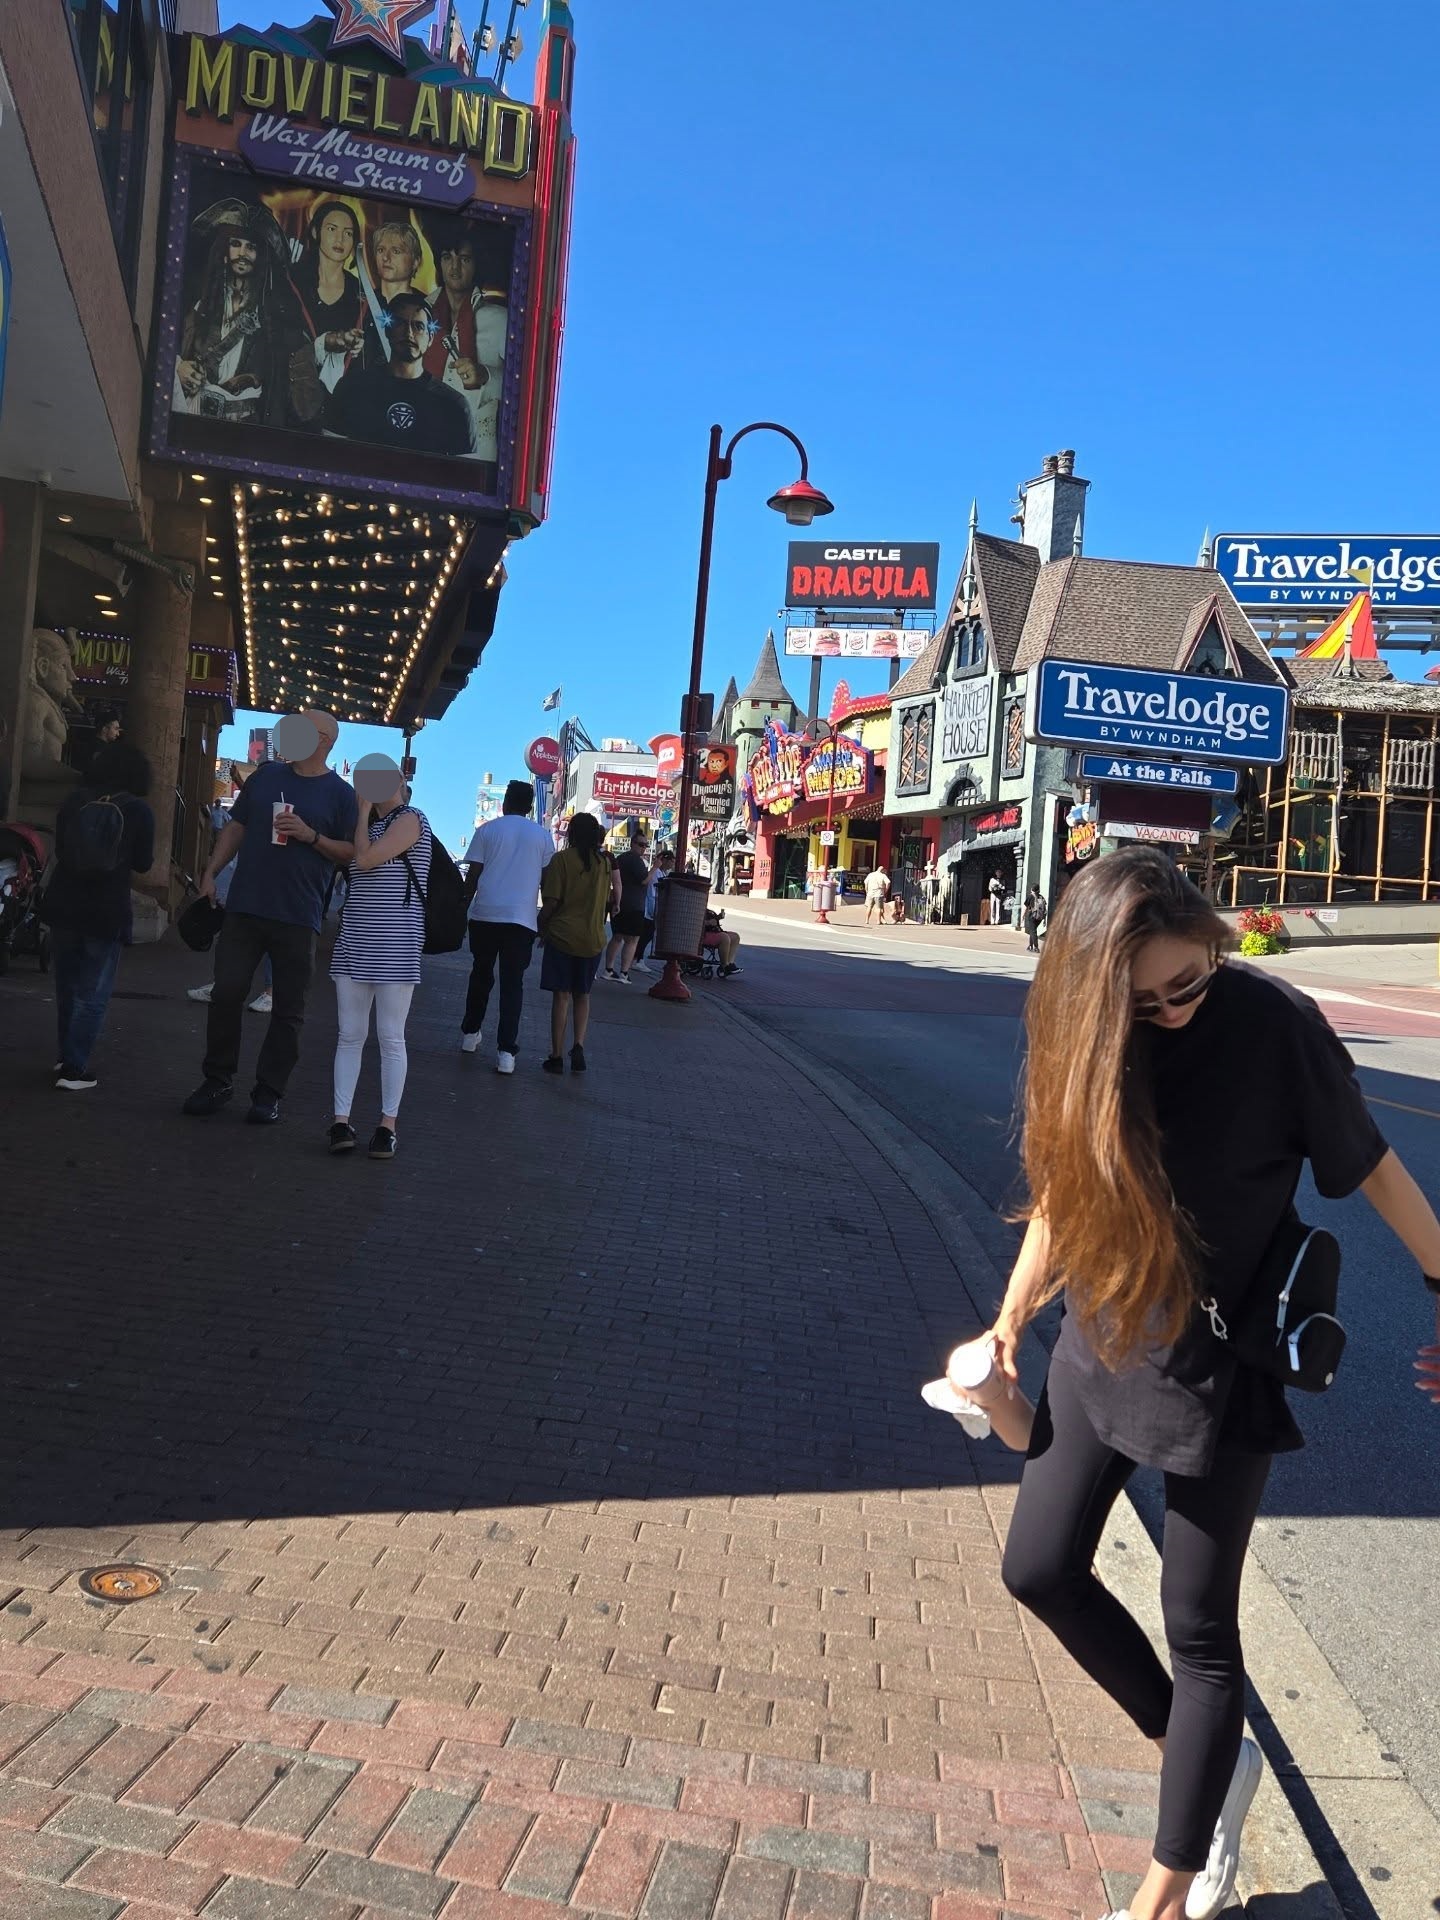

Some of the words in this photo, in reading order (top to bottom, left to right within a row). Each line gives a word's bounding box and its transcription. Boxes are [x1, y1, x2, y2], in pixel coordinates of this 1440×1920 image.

[185, 33, 533, 179] MOVIELAND
[249, 112, 309, 146] Wax
[314, 128, 430, 171] Museum
[435, 153, 467, 187] of
[289, 151, 338, 180] The
[342, 163, 423, 196] Stars
[824, 548, 901, 561] CASTLE
[792, 565, 930, 600] DRACULA
[1270, 589, 1291, 600] BY
[1301, 590, 1397, 601] WYNDAM
[961, 682, 974, 693] THE
[945, 684, 990, 720] HAUNTED
[1058, 669, 1270, 741] Travelodge
[943, 719, 986, 758] HOUSE
[1100, 726, 1121, 738] BY
[1130, 728, 1222, 749] WYNDHAM
[1107, 761, 1132, 777] At
[1135, 765, 1165, 780] the
[1170, 768, 1212, 786] Falls
[596, 777, 676, 800] Thriftlodge
[619, 806, 627, 814] At
[638, 808, 652, 816] Falls
[701, 796, 730, 808] Haunted
[703, 804, 727, 815] Castle
[1134, 826, 1196, 843] VACANCY
